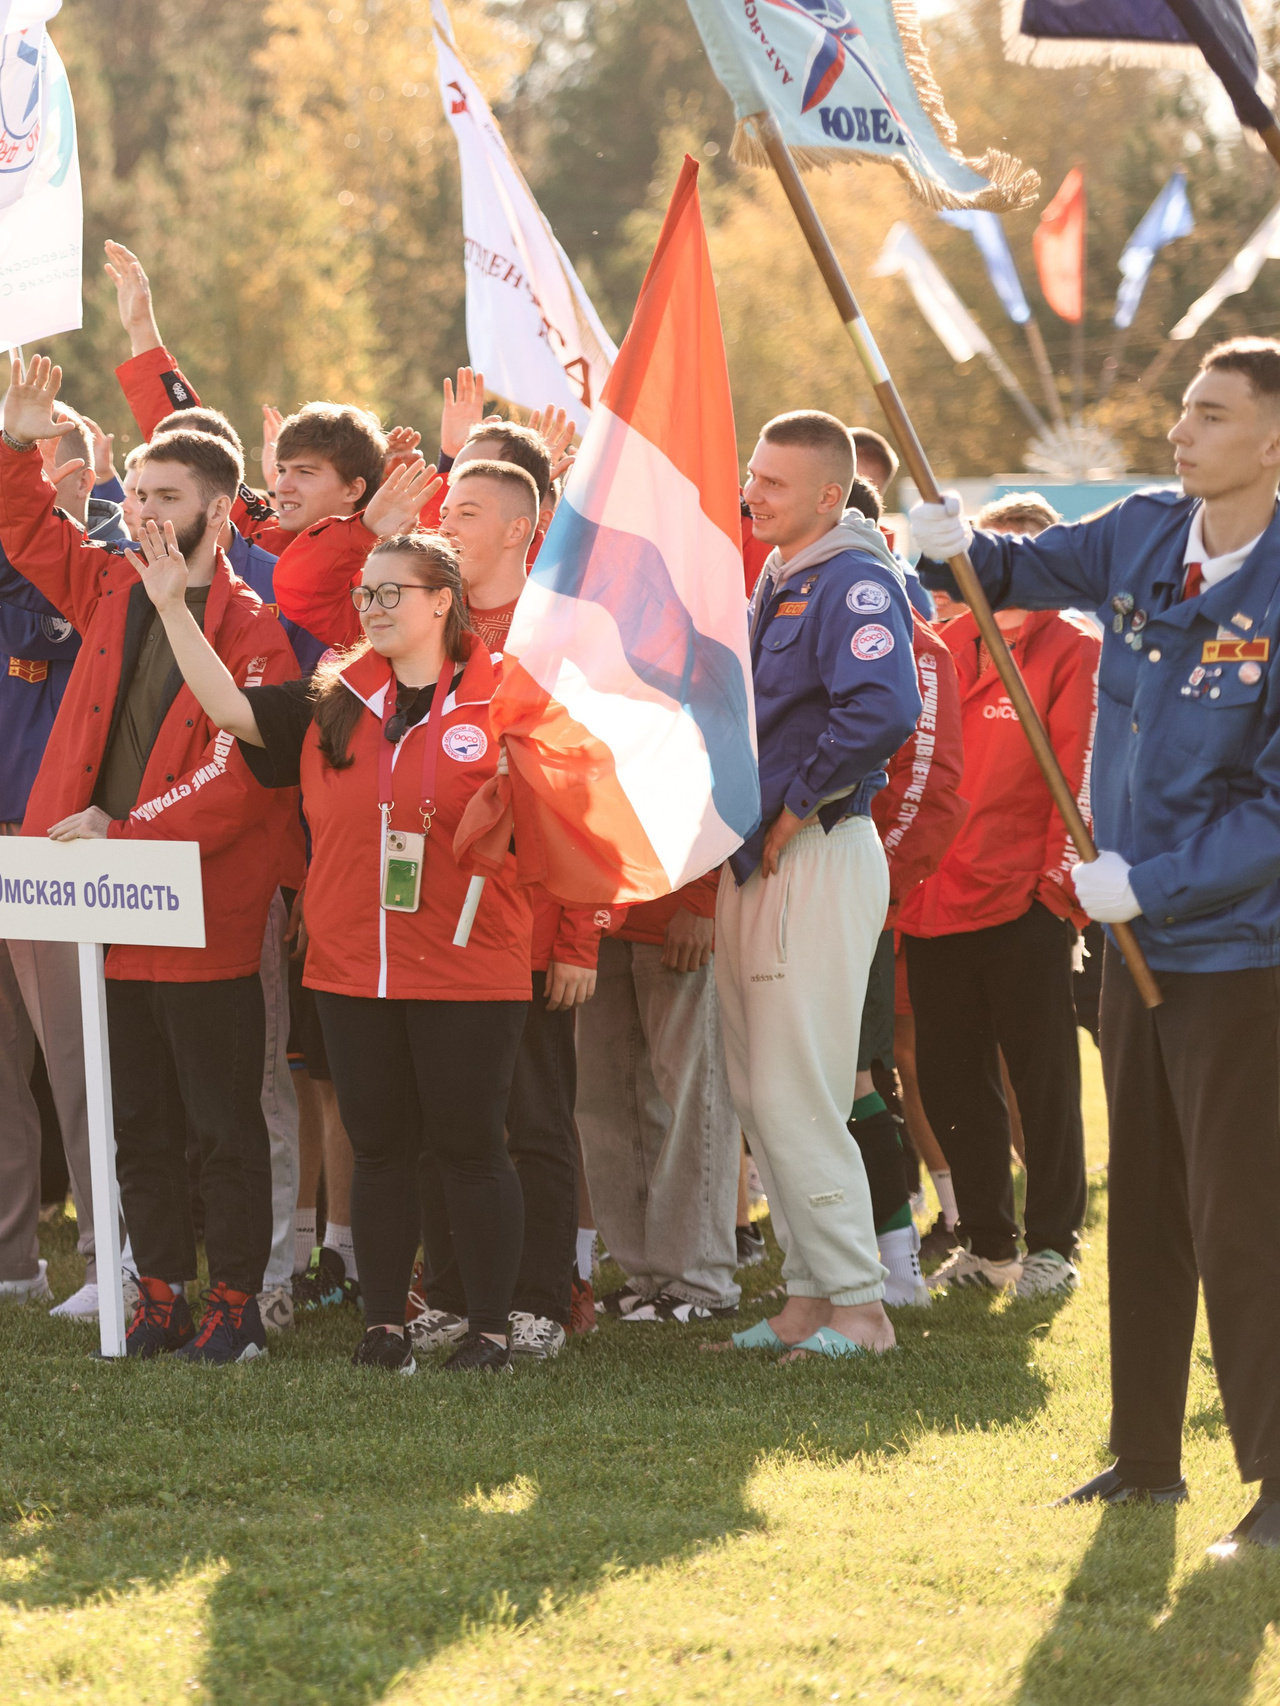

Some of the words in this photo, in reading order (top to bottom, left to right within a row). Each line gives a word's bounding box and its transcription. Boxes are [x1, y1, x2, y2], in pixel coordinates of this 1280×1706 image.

[743, 0, 794, 85] АЛТАЙС
[860, 632, 883, 644] ООСО
[454, 734, 479, 744] ООСО
[83, 874, 180, 911] область
